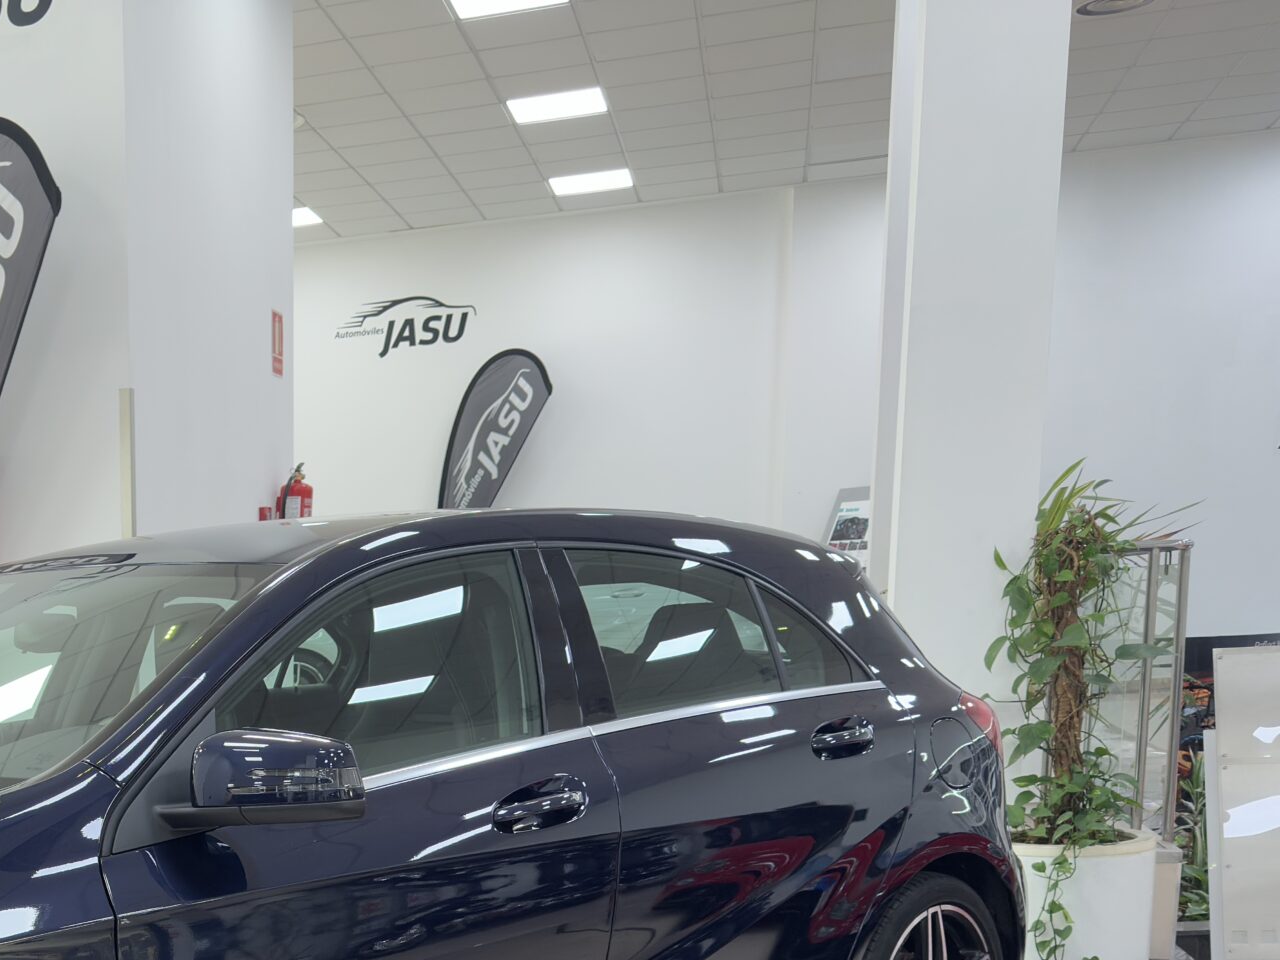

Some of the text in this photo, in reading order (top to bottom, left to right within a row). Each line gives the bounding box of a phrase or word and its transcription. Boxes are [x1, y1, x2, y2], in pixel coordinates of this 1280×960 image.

[334, 312, 469, 358] Automóviles JASU
[459, 377, 534, 509] móviles JASU
